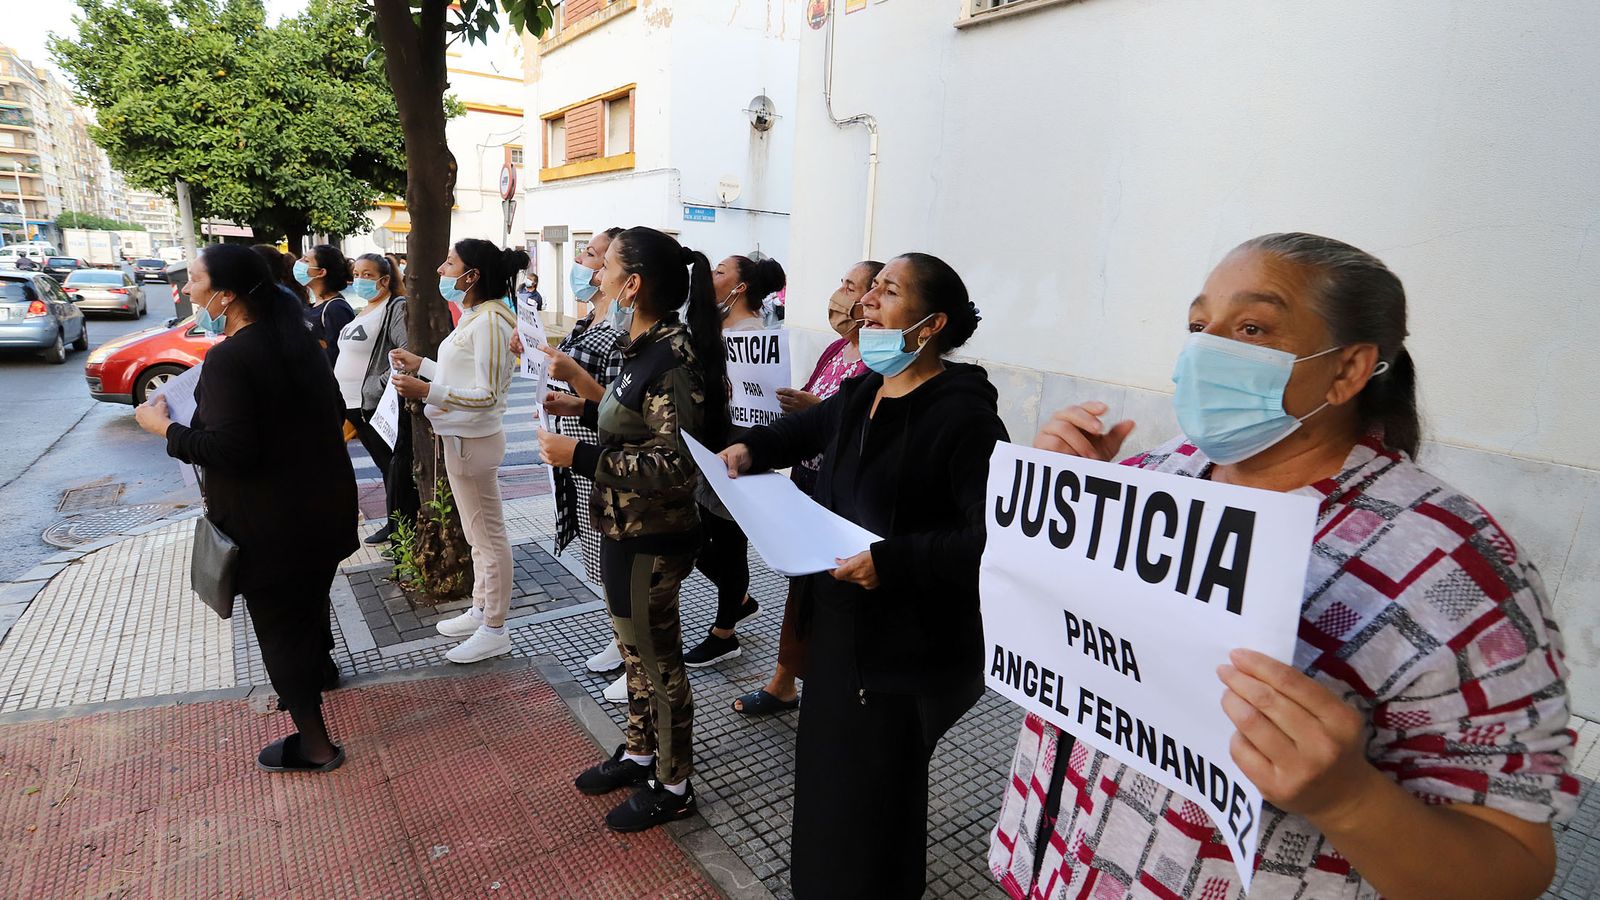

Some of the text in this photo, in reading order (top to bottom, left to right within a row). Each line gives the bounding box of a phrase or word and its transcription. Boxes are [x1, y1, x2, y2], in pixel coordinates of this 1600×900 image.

[731, 405, 748, 422] NGEL
[743, 381, 764, 397] PARA
[995, 459, 1256, 616] JUSTICIA
[1064, 609, 1141, 682] PARA
[990, 644, 1253, 858] ANGEL FERNANDEZ
